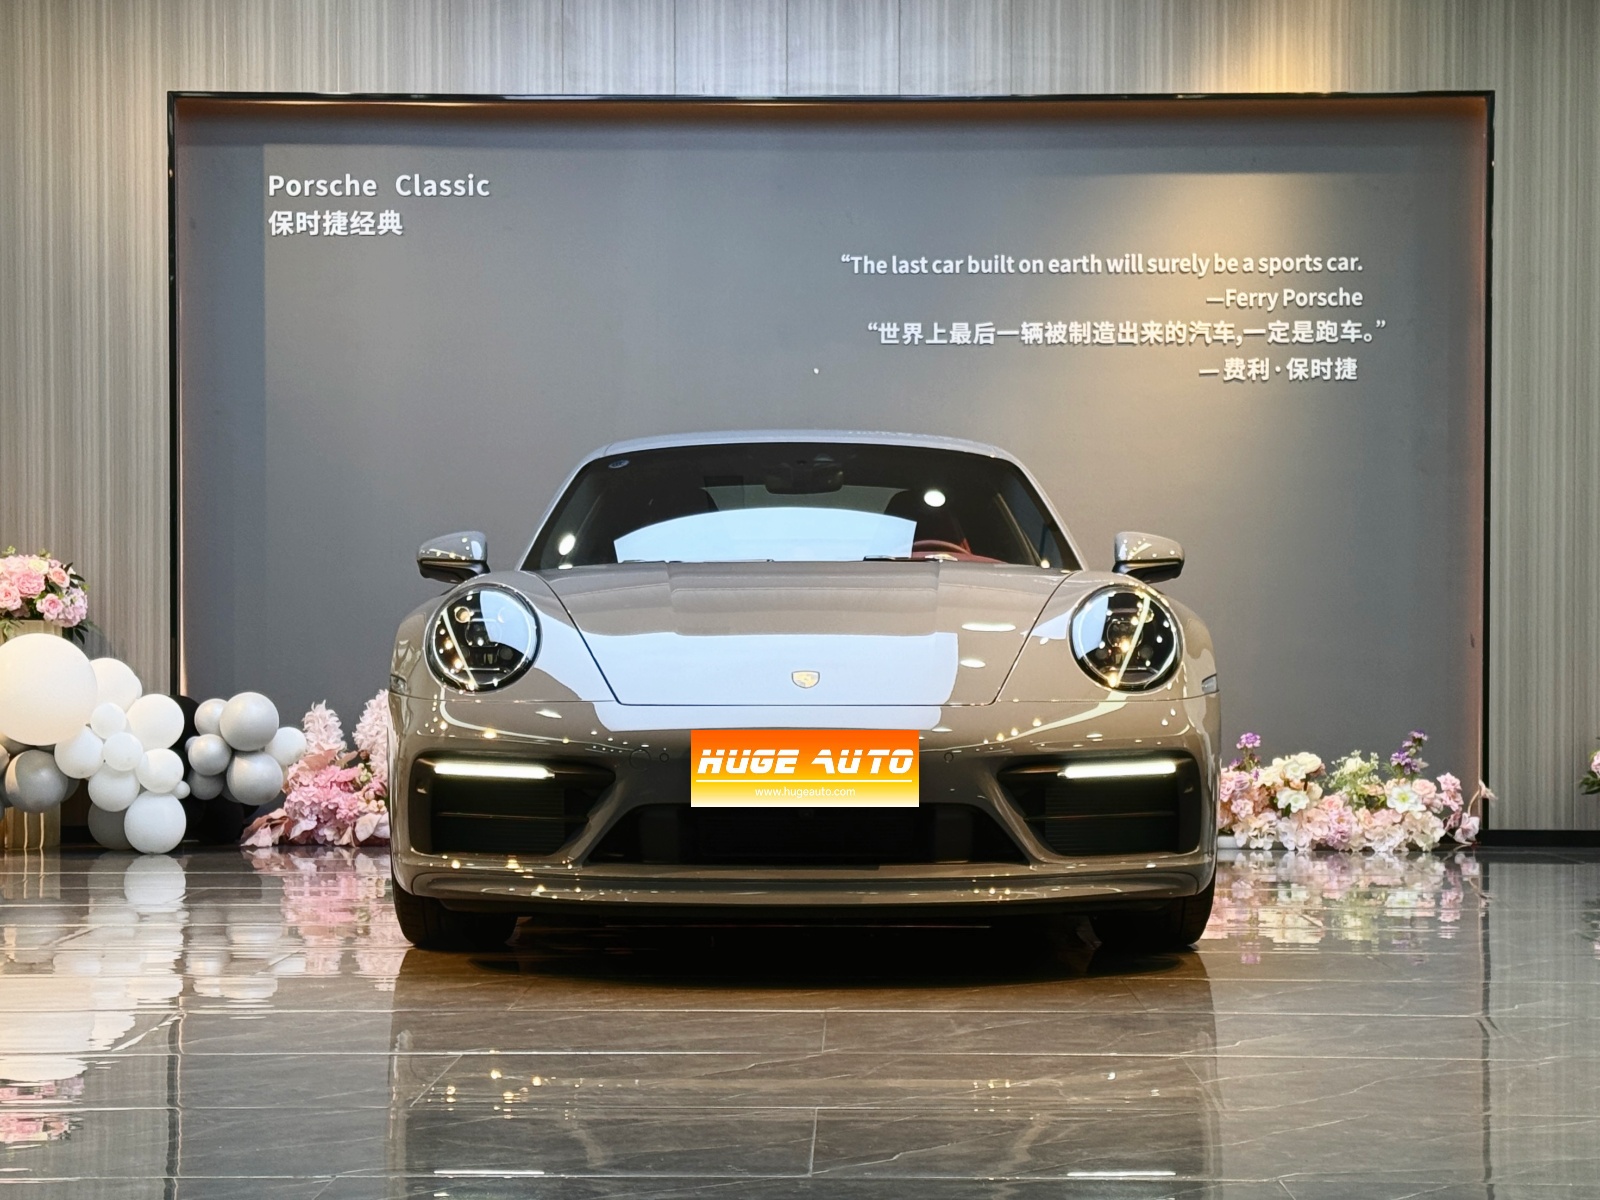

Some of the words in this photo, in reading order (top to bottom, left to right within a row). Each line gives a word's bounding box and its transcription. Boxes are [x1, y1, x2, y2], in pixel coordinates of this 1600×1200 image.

[268, 173, 377, 197] Porsche
[395, 173, 490, 197] Classic
[268, 210, 403, 236] 保时捷经典
[841, 254, 888, 274] “The
[892, 255, 928, 274] last
[932, 258, 964, 274] car
[967, 255, 1015, 274] built
[1018, 258, 1044, 273] on
[1048, 255, 1102, 274] earth
[1107, 254, 1144, 273] will
[1147, 254, 1210, 277] surely
[1214, 254, 1238, 273] be
[1242, 258, 1254, 273] a
[1258, 256, 1323, 276] sports
[1327, 256, 1363, 272] car.
[1283, 287, 1363, 307] Porsche
